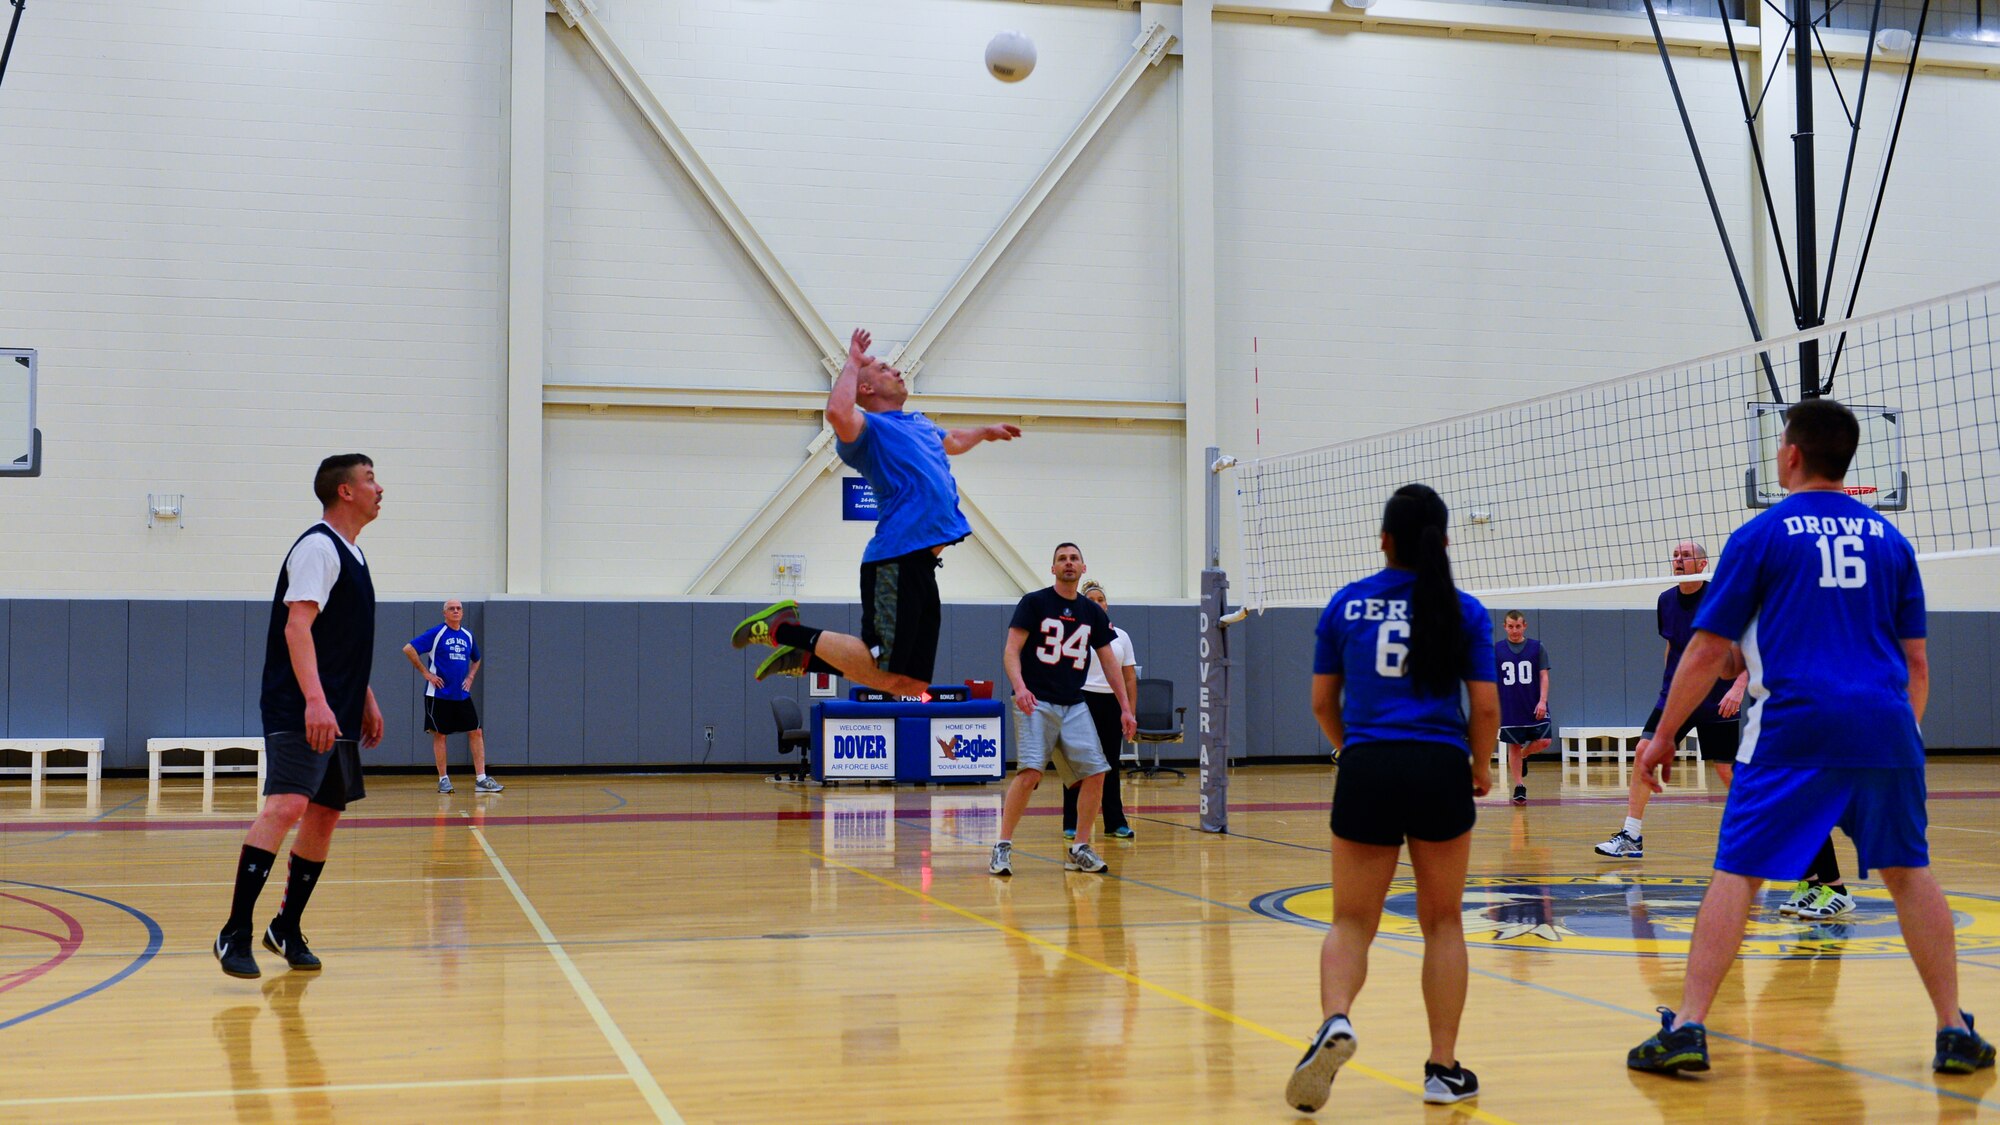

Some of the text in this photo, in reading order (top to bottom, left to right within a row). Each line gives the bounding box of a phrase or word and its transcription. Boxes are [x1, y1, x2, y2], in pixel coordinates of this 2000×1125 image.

[1783, 515, 1884, 538] DROWN
[1815, 534, 1867, 588] 16
[1344, 598, 1414, 620] CER
[1036, 617, 1092, 670] 34
[1375, 620, 1411, 677] 6
[1501, 660, 1532, 685] 30
[1200, 612, 1210, 815] DOVER AFB
[834, 735, 887, 759] DOVER
[954, 734, 997, 762] Eagles
